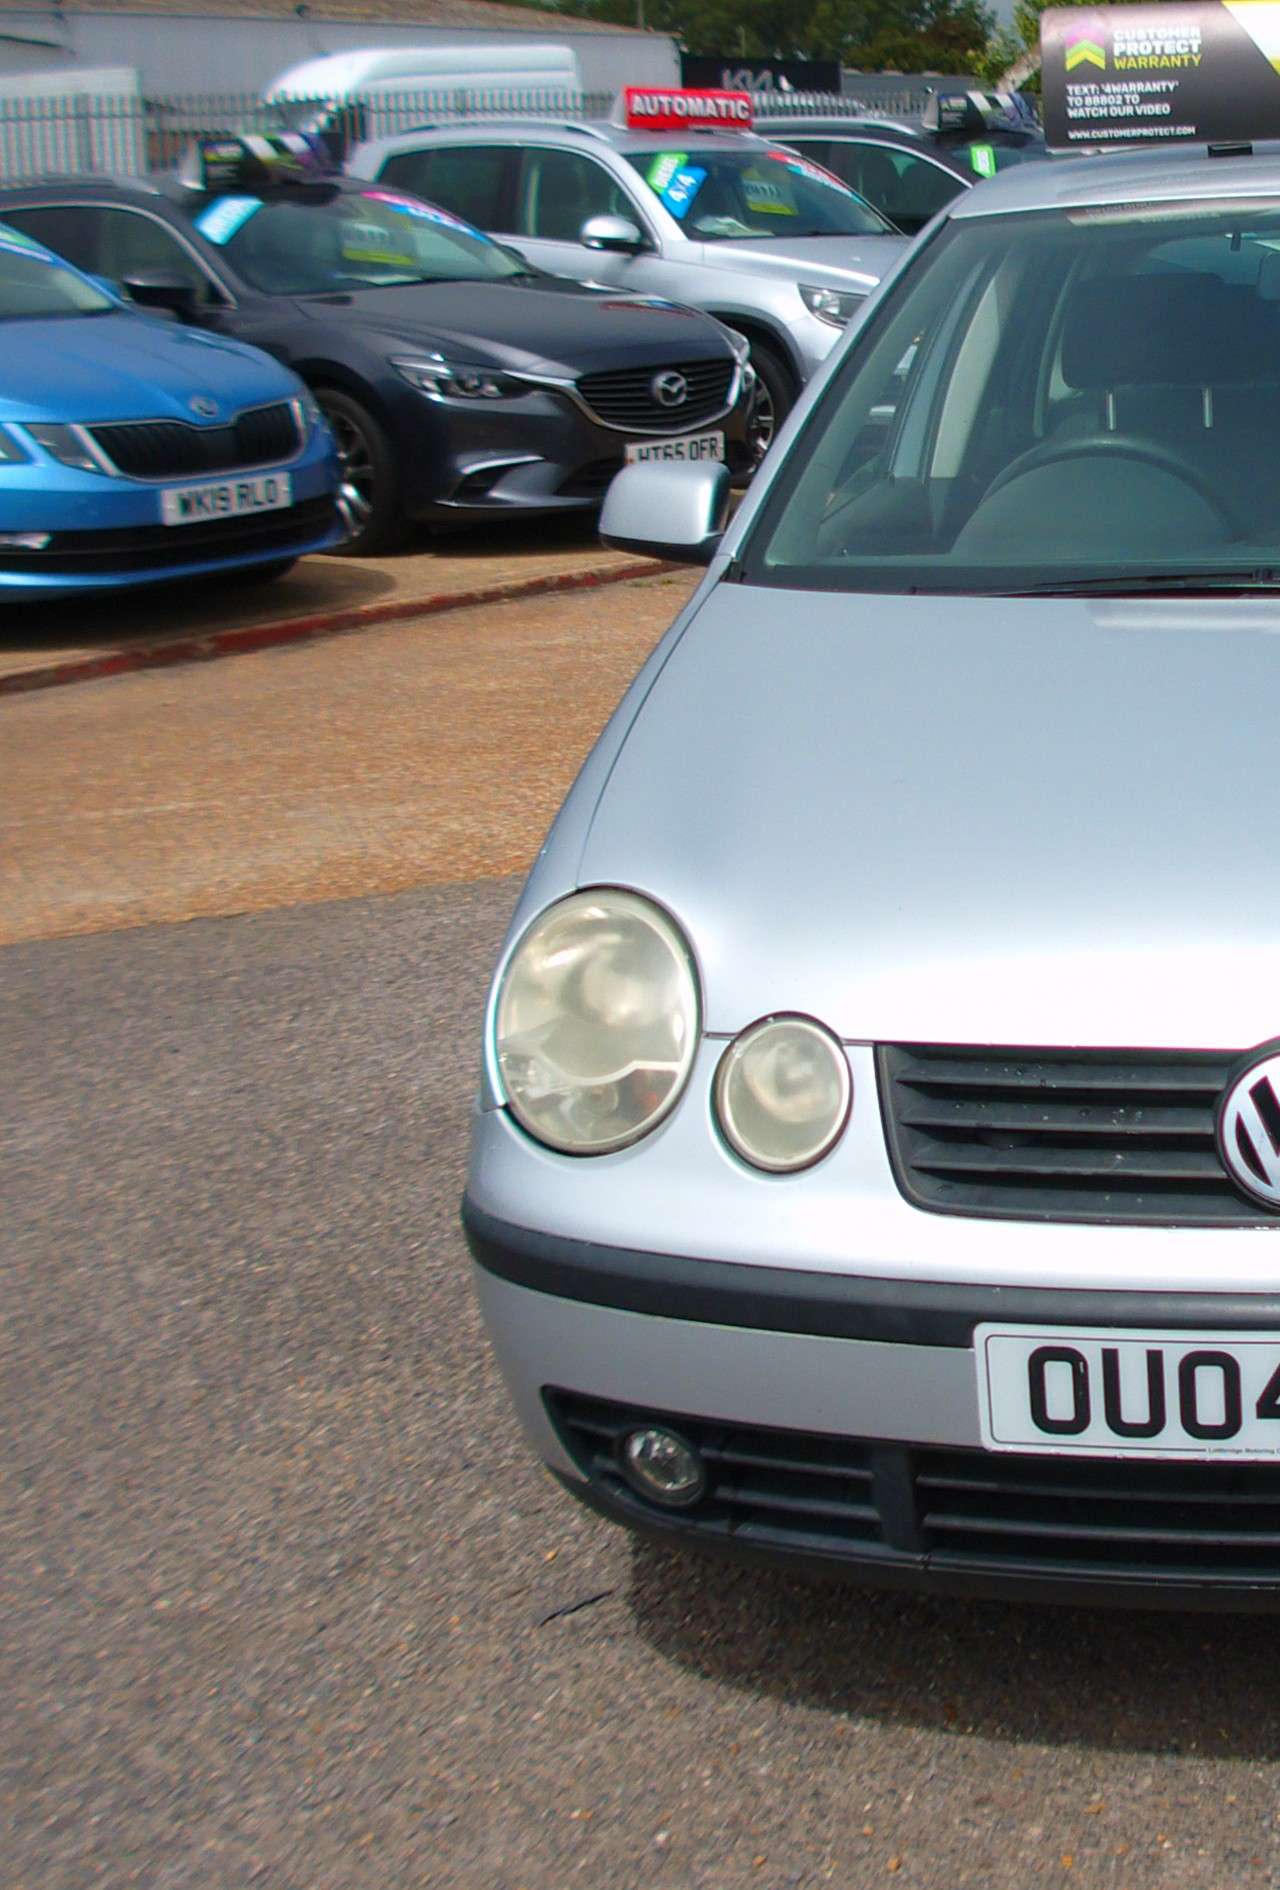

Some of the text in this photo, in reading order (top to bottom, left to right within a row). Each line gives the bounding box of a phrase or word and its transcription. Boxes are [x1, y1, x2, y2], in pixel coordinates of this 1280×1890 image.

[1113, 26, 1201, 41] CUSTOMER
[1113, 39, 1202, 56] PROTECT
[1114, 54, 1202, 70] WARRANTY
[1066, 84, 1099, 96] TEXT:
[631, 94, 751, 120] AUTOMATIC
[1067, 96, 1083, 107] TO
[1126, 94, 1141, 104] TO
[1067, 103, 1171, 119] WATCH OUR VIDEO
[1067, 125, 1197, 140] WWW.CUSTOMERPROTECT.COM
